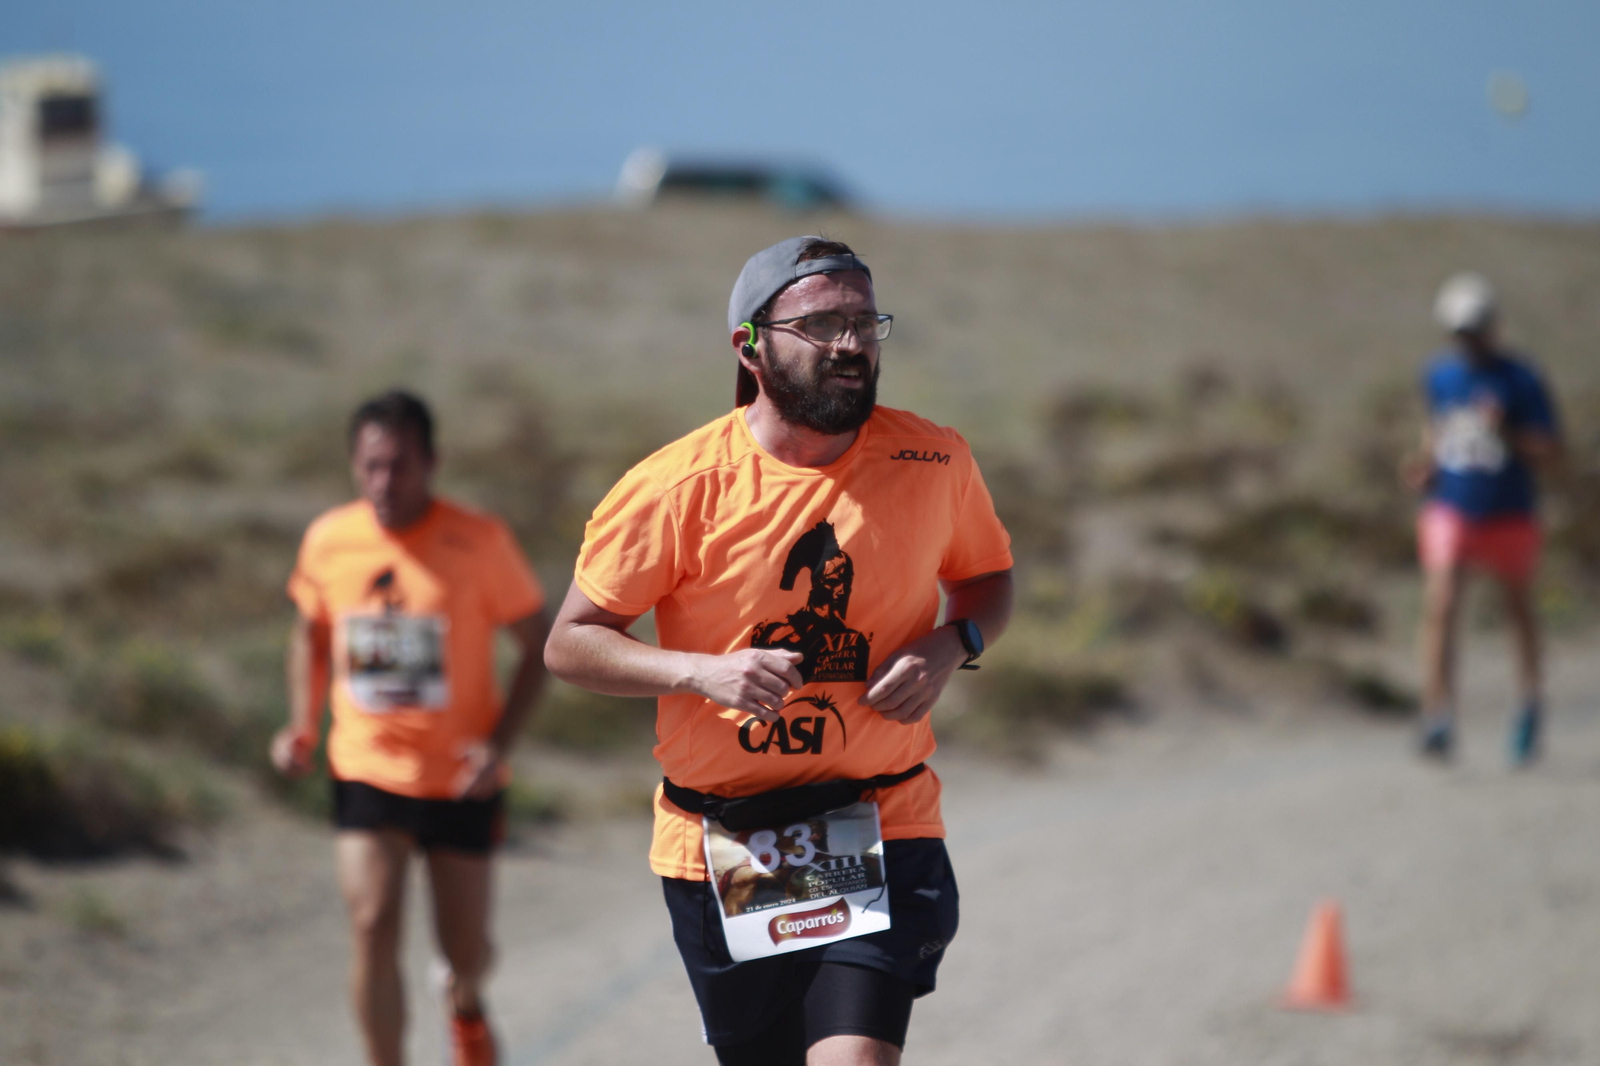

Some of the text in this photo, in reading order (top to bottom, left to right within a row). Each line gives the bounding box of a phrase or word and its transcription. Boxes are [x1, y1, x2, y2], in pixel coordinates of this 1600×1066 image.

[738, 715, 826, 755] CASI
[748, 824, 816, 873] 83
[806, 854, 864, 874] XIII
[805, 866, 866, 881] CARRERA
[808, 872, 866, 888] POPULAR
[821, 879, 868, 891] ESPARTANOS
[779, 898, 796, 906] 2024
